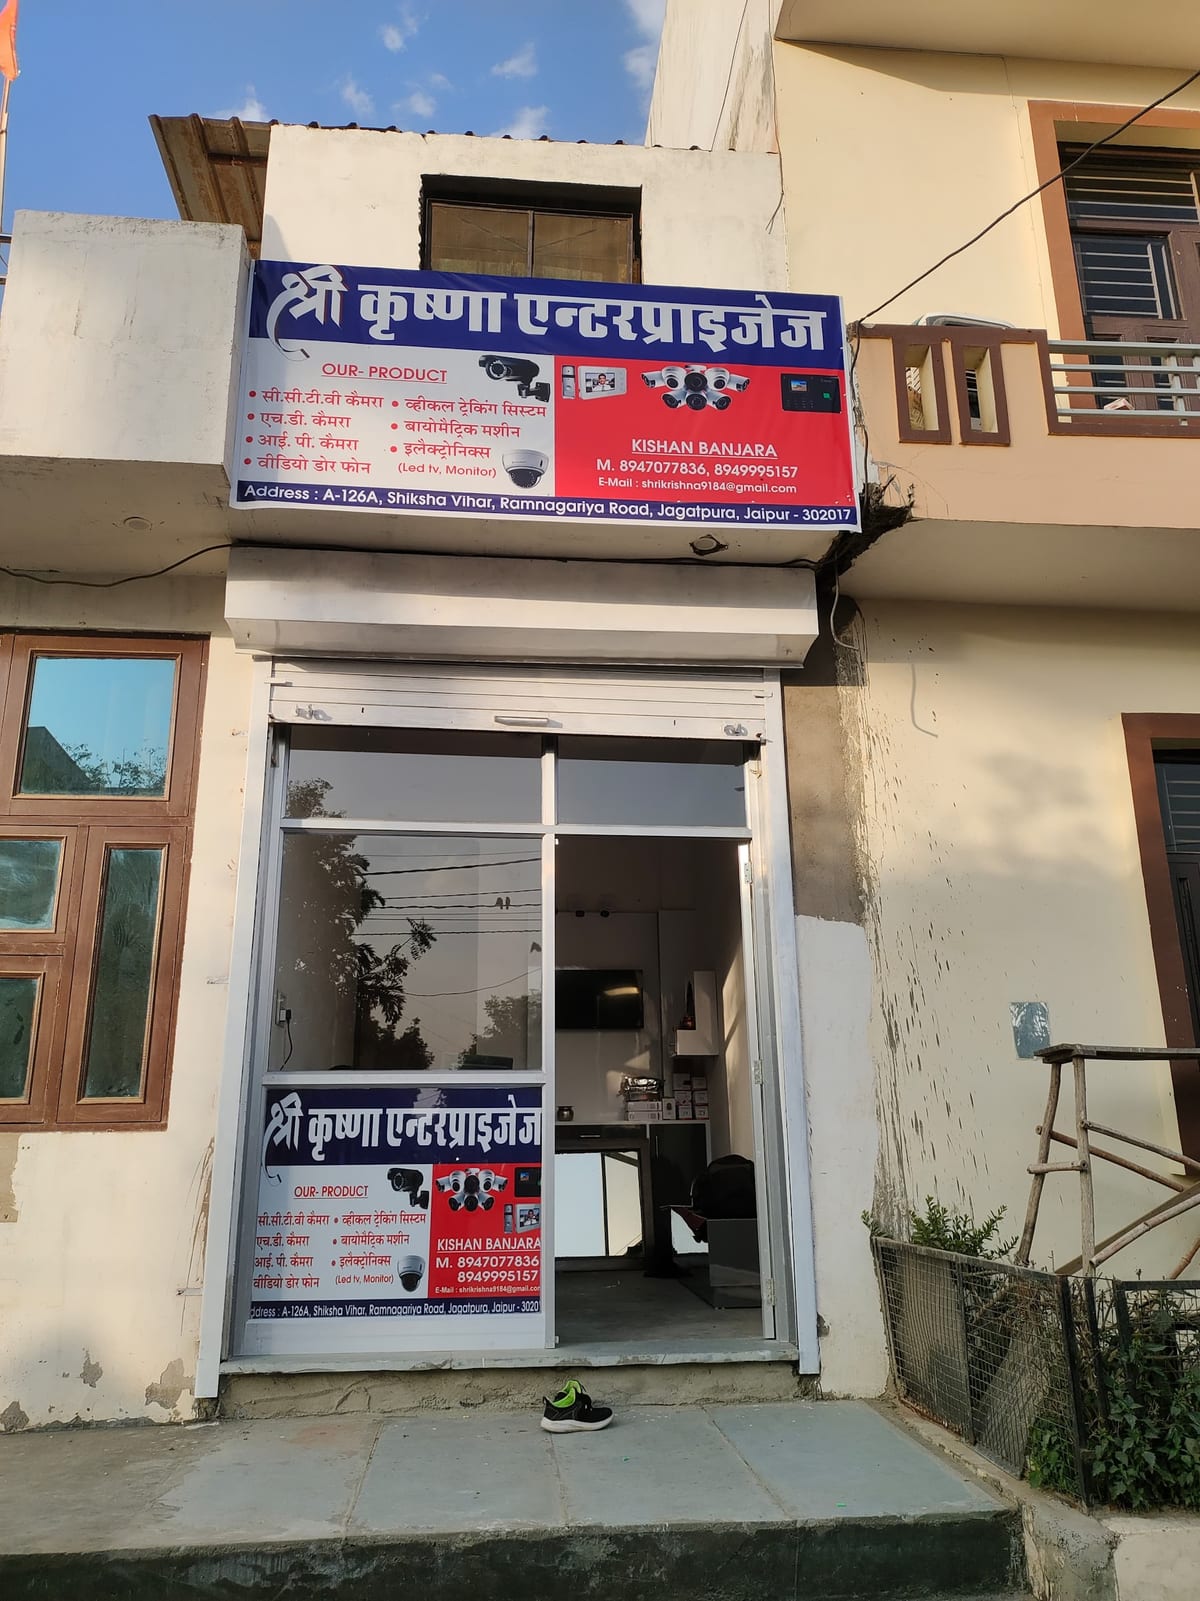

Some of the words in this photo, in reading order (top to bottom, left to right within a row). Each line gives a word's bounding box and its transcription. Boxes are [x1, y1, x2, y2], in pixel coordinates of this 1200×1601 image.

[266, 264, 348, 354] श्री
[357, 285, 507, 341] कृष्णा
[514, 293, 827, 352] एन्टरप्राइजेज
[322, 363, 365, 377] OUR-
[369, 366, 448, 383] PRODUCT
[261, 387, 342, 404] सी.सी.टी.वी
[345, 390, 385, 408] कैमरा
[404, 395, 455, 413] व्हीकल
[458, 396, 498, 416] ट्रेकिंग
[502, 400, 547, 417] सिस्टम
[260, 410, 308, 428] एच.डी.
[311, 410, 351, 428] कैमरा
[481, 421, 521, 438] मशीन
[319, 432, 359, 450] कैमरा
[631, 438, 694, 454] KISHAN
[698, 441, 778, 457] BANJARA
[257, 453, 309, 470] वीडियो
[312, 455, 337, 472] डोर
[340, 456, 371, 474] फोन
[397, 462, 425, 474] (Led
[428, 464, 442, 475] tv,
[446, 465, 497, 478] Monitor)
[596, 458, 615, 471] M.
[619, 460, 710, 477] 8947077836,
[714, 463, 798, 478] 8949995157
[598, 476, 633, 488] E-Mail
[641, 479, 797, 494] shrikrishna9184@gmail.com
[244, 484, 310, 500] Address
[322, 488, 383, 505] A-126A,
[387, 491, 447, 507] Shiksha
[451, 494, 496, 511] Vihar,
[500, 497, 605, 516] Ramnagariya
[609, 502, 653, 518] Road,
[657, 503, 740, 521] Jagatpura,
[743, 506, 790, 522] Jaipur
[802, 508, 851, 521] 302017
[262, 1091, 304, 1177] श्री
[308, 1108, 383, 1161] कृष्णा
[386, 1094, 542, 1153] एन्टरप्राइजेज
[294, 1185, 319, 1198] OUR-
[321, 1185, 369, 1197] PRODUCT
[307, 1210, 330, 1225] कैमरा
[342, 1211, 372, 1226] व्हीकल
[400, 1210, 426, 1225] सिस्टम
[286, 1231, 310, 1247] कैमरा
[386, 1230, 410, 1246] मशीन
[437, 1238, 482, 1251] KISHAN
[485, 1237, 541, 1250] BANJARA
[290, 1252, 313, 1267] कैमरा
[435, 1257, 453, 1268] M.
[457, 1255, 540, 1268] 8947077836
[253, 1274, 283, 1289] वीडियो
[285, 1273, 299, 1289] डोर
[302, 1273, 320, 1288] फोन
[335, 1275, 351, 1285] (Led
[363, 1274, 394, 1285] Monitor)
[457, 1269, 539, 1283] 8949995157
[250, 1305, 276, 1318] ddress
[313, 1304, 343, 1317] Shiksha
[369, 1303, 422, 1316] Ramnagariya
[492, 1301, 515, 1314] Jaipur
